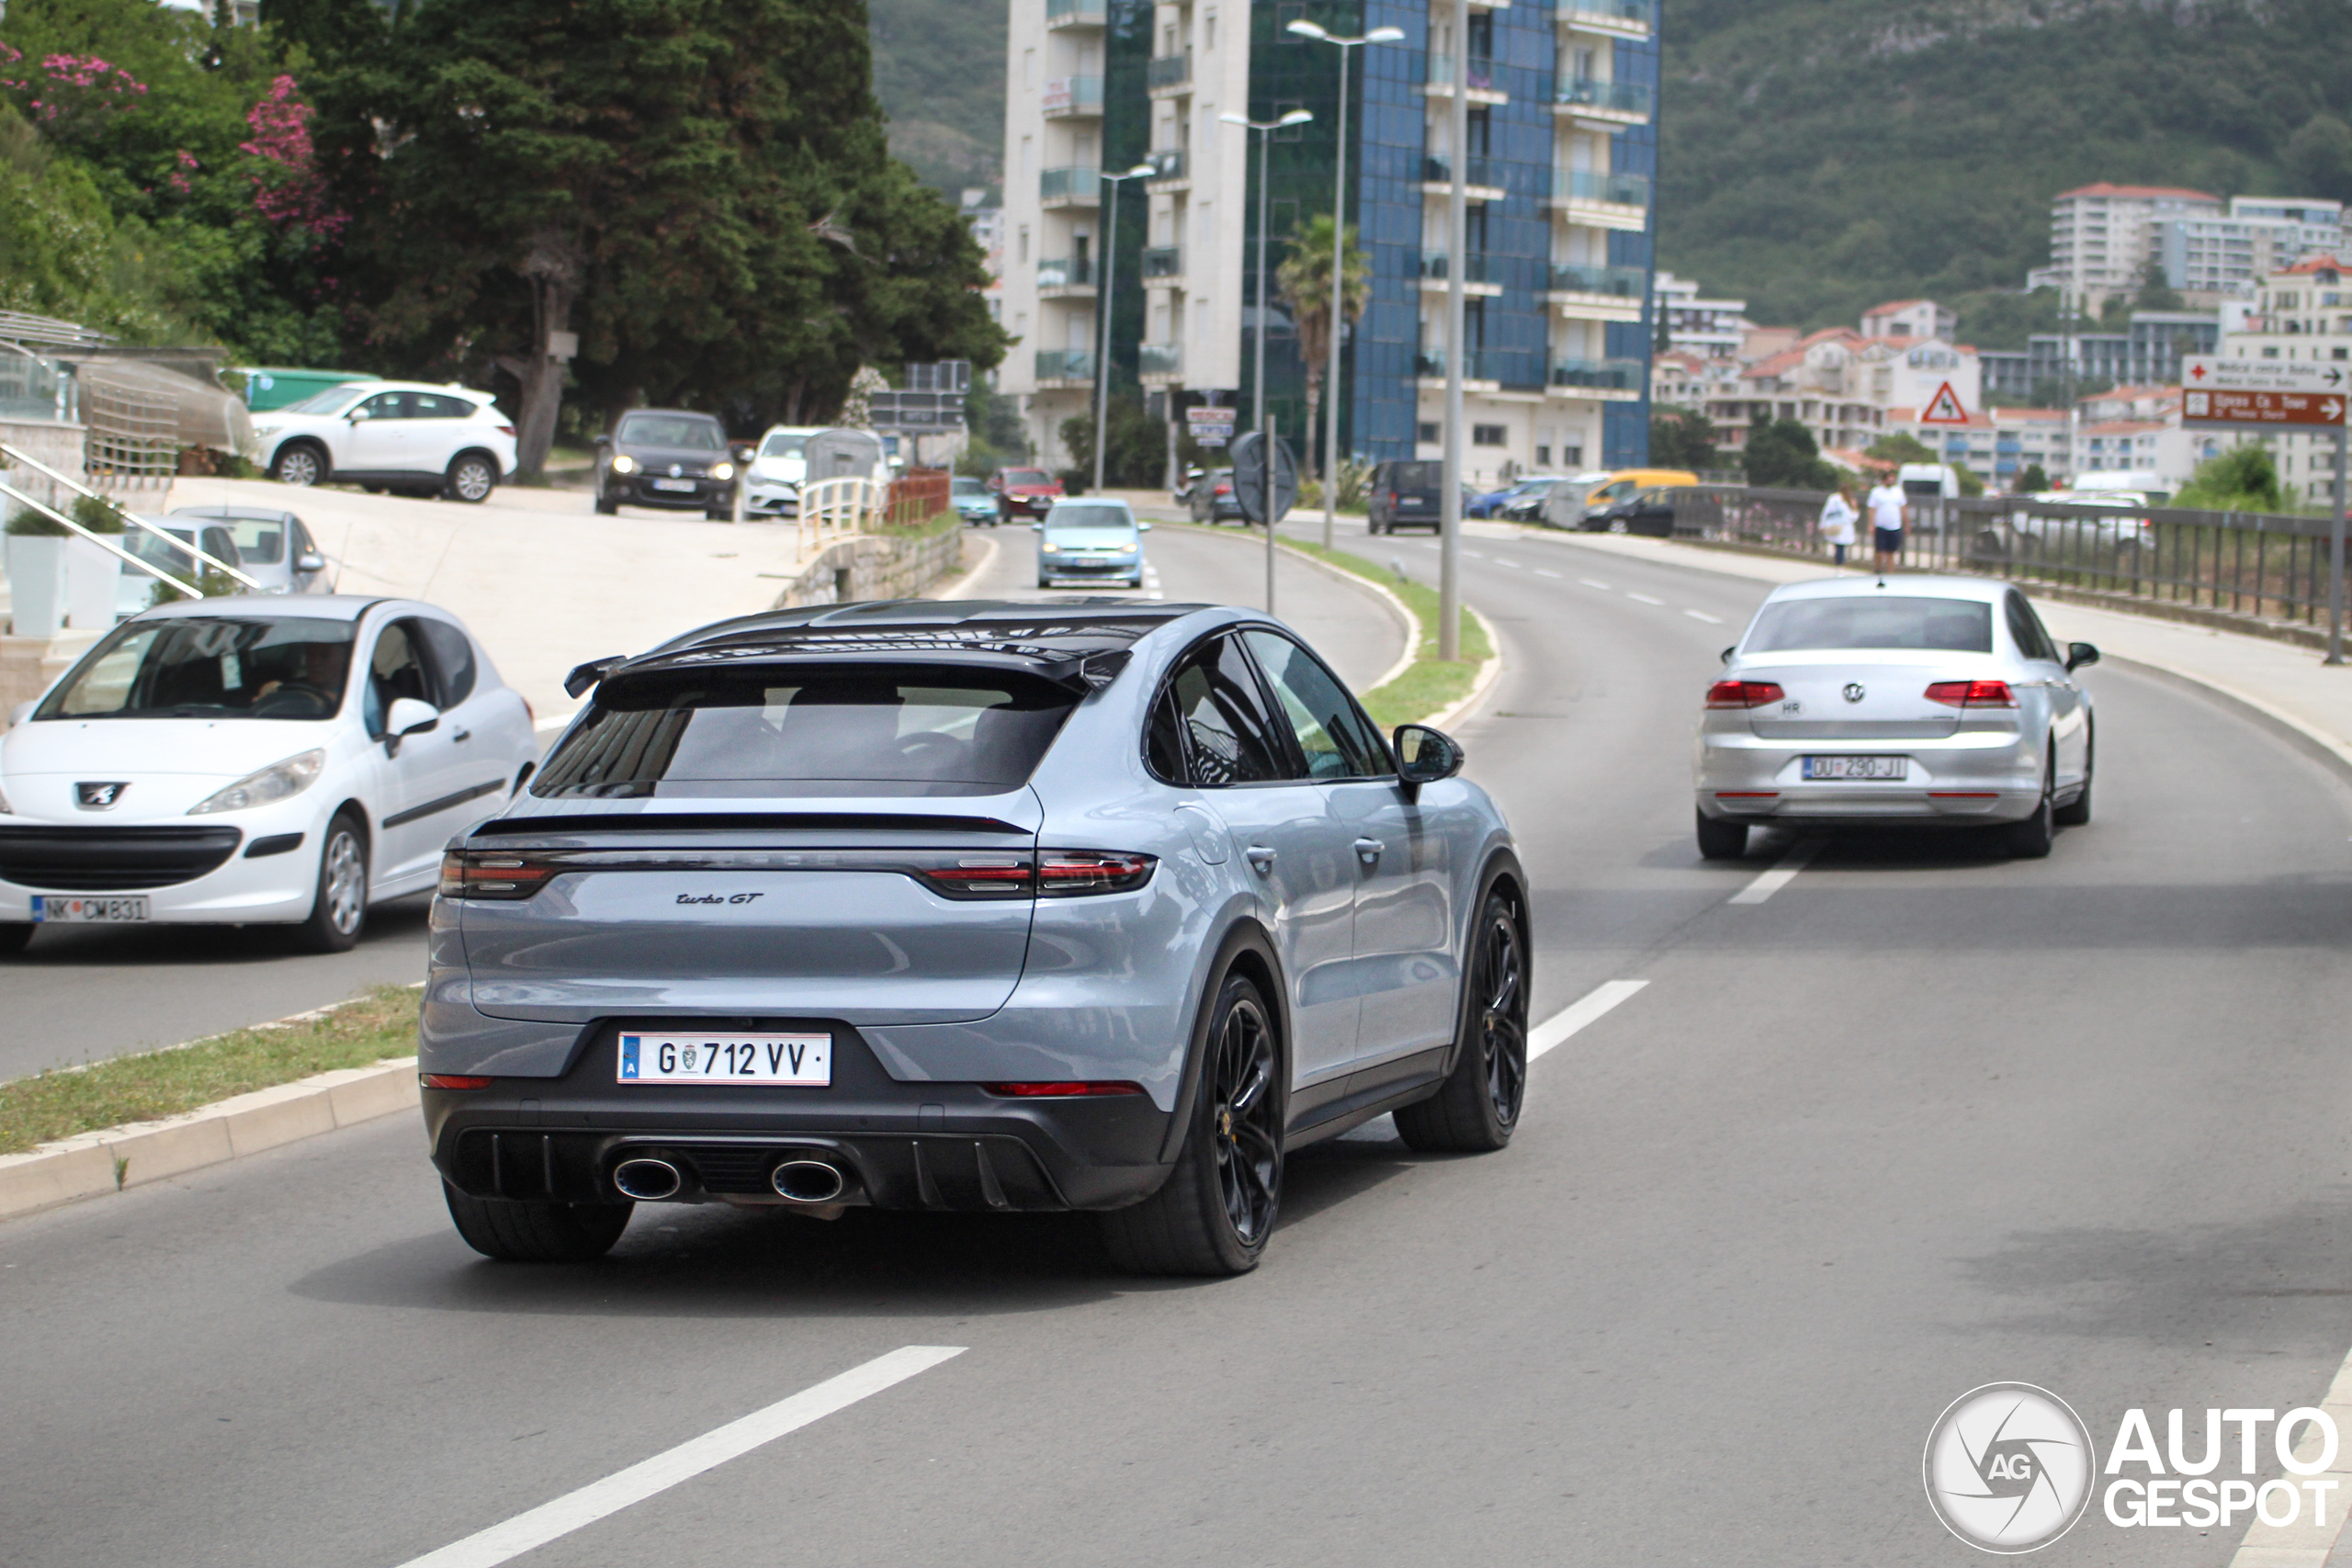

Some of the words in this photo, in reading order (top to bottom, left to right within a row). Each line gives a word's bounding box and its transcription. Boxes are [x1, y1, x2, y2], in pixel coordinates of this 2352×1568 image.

[1783, 703, 1800, 714] HR
[1814, 760, 1833, 776] DU
[676, 894, 725, 904] turbo
[729, 893, 764, 904] GT
[660, 1043, 676, 1074] G
[704, 1043, 756, 1075] 712
[767, 1043, 806, 1076] VV
[626, 1062, 636, 1074] A
